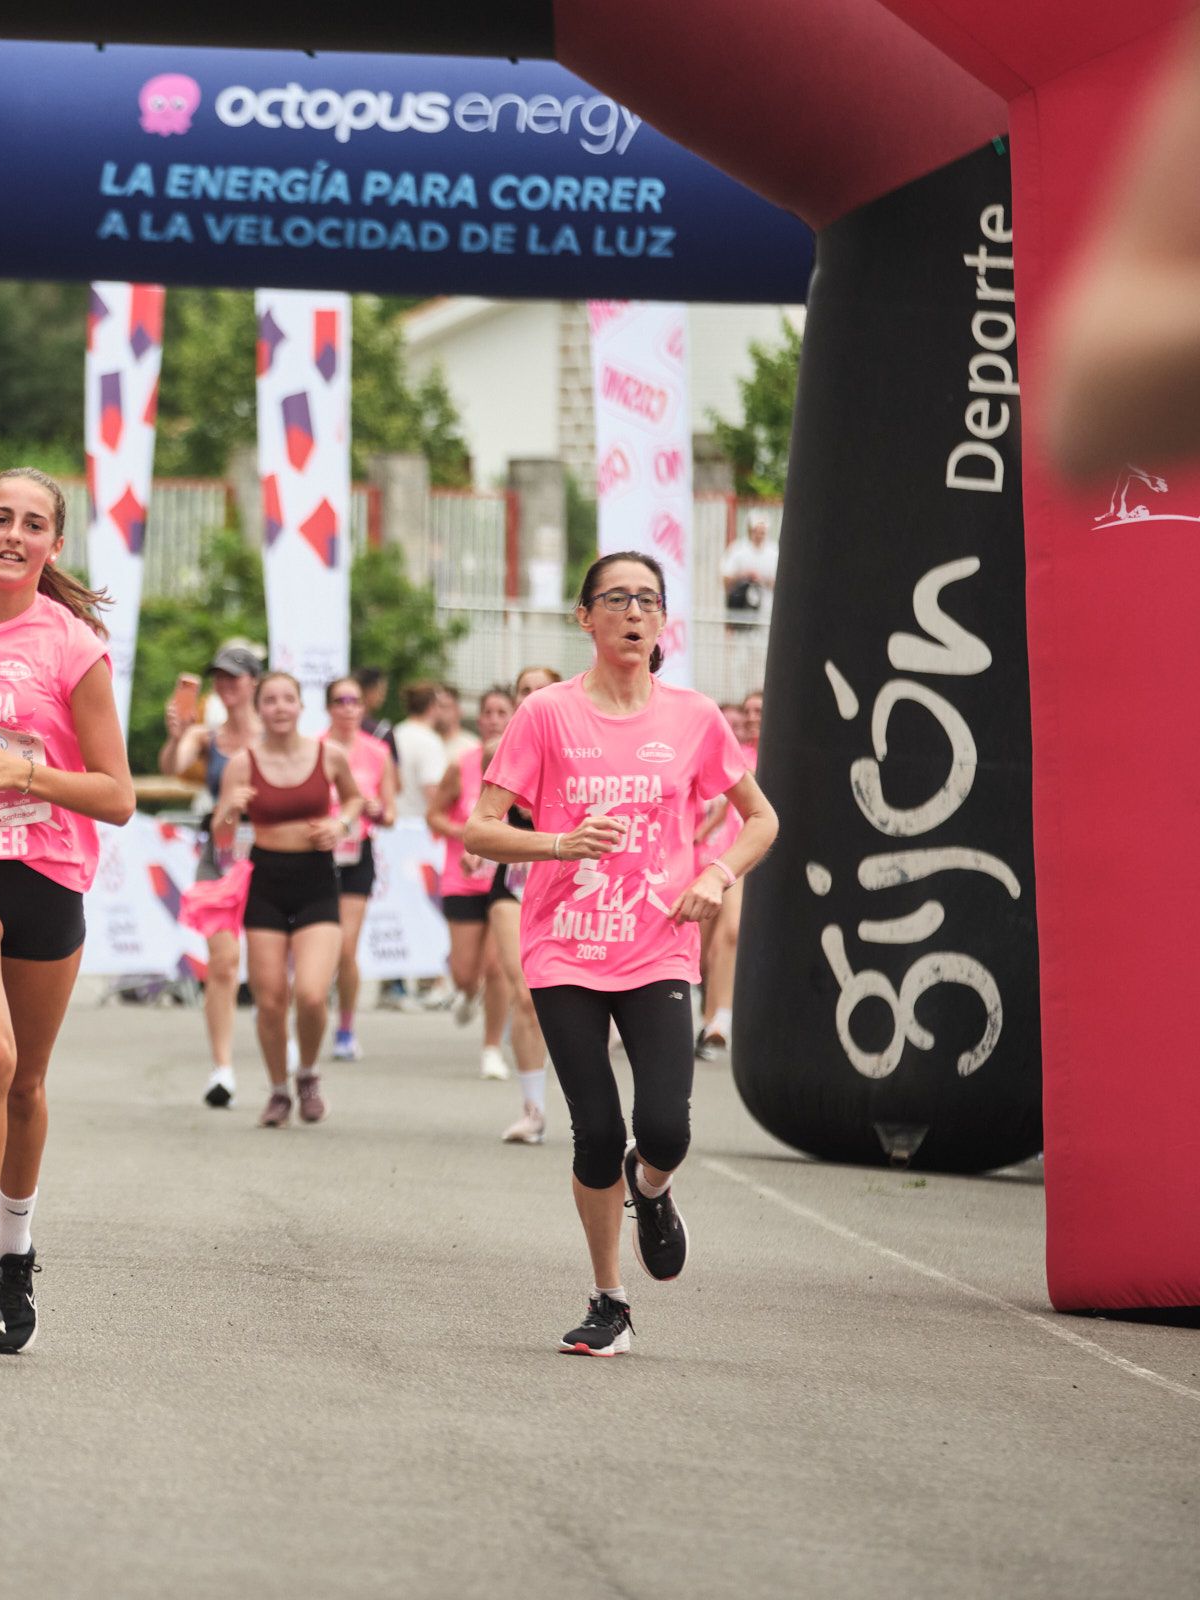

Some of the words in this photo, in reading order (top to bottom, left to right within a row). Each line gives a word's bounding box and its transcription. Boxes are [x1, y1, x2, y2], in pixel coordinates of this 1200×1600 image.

[102, 162, 154, 197] LA
[165, 160, 350, 205] ENERGÍA
[363, 171, 477, 210] PARA
[490, 174, 666, 214] CORRER
[100, 211, 129, 240] A
[139, 212, 194, 243] LA
[204, 214, 450, 252] VELOCIDAD
[460, 221, 517, 255] DE
[527, 225, 582, 257] LA
[593, 226, 678, 259] LUZ
[807, 556, 1020, 1078] gijón
[946, 203, 1020, 492] Deporte
[566, 774, 663, 805] CARRERA
[596, 875, 624, 912] LA
[551, 910, 637, 942] MUJER
[576, 943, 607, 961] 2026
